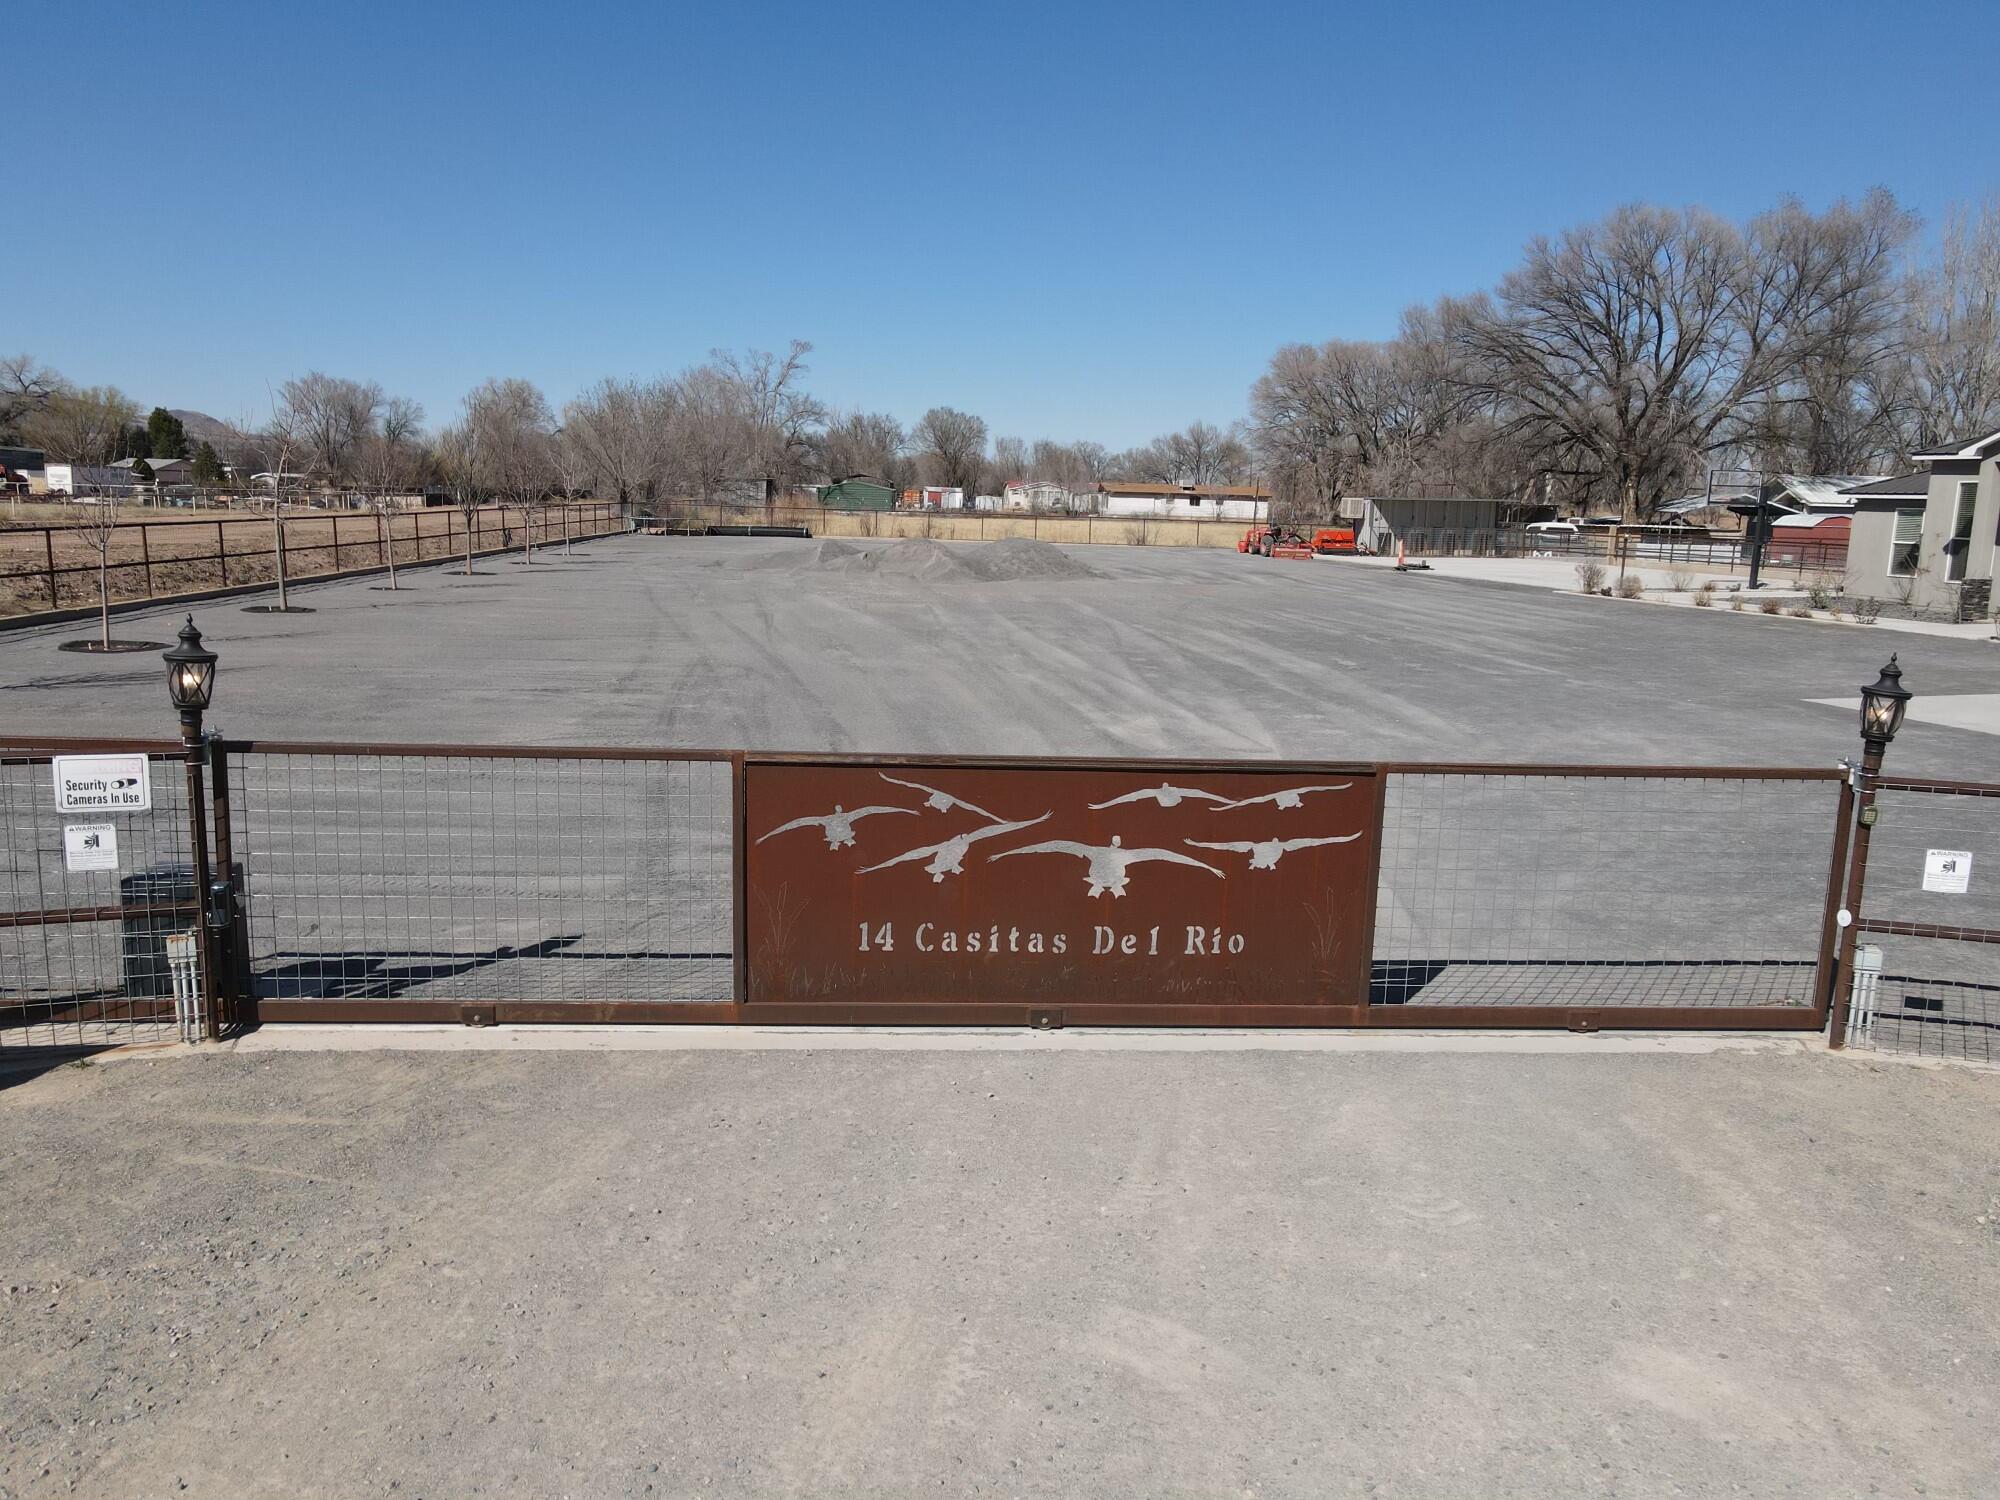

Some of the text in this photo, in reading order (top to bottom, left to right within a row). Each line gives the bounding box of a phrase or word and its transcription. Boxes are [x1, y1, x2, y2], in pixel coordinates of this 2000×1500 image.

[65, 779, 107, 792] Security
[66, 792, 140, 805] Cameras In Use
[75, 824, 111, 832] WARNING
[858, 922, 1245, 955] 14 Casitas Del Rio
